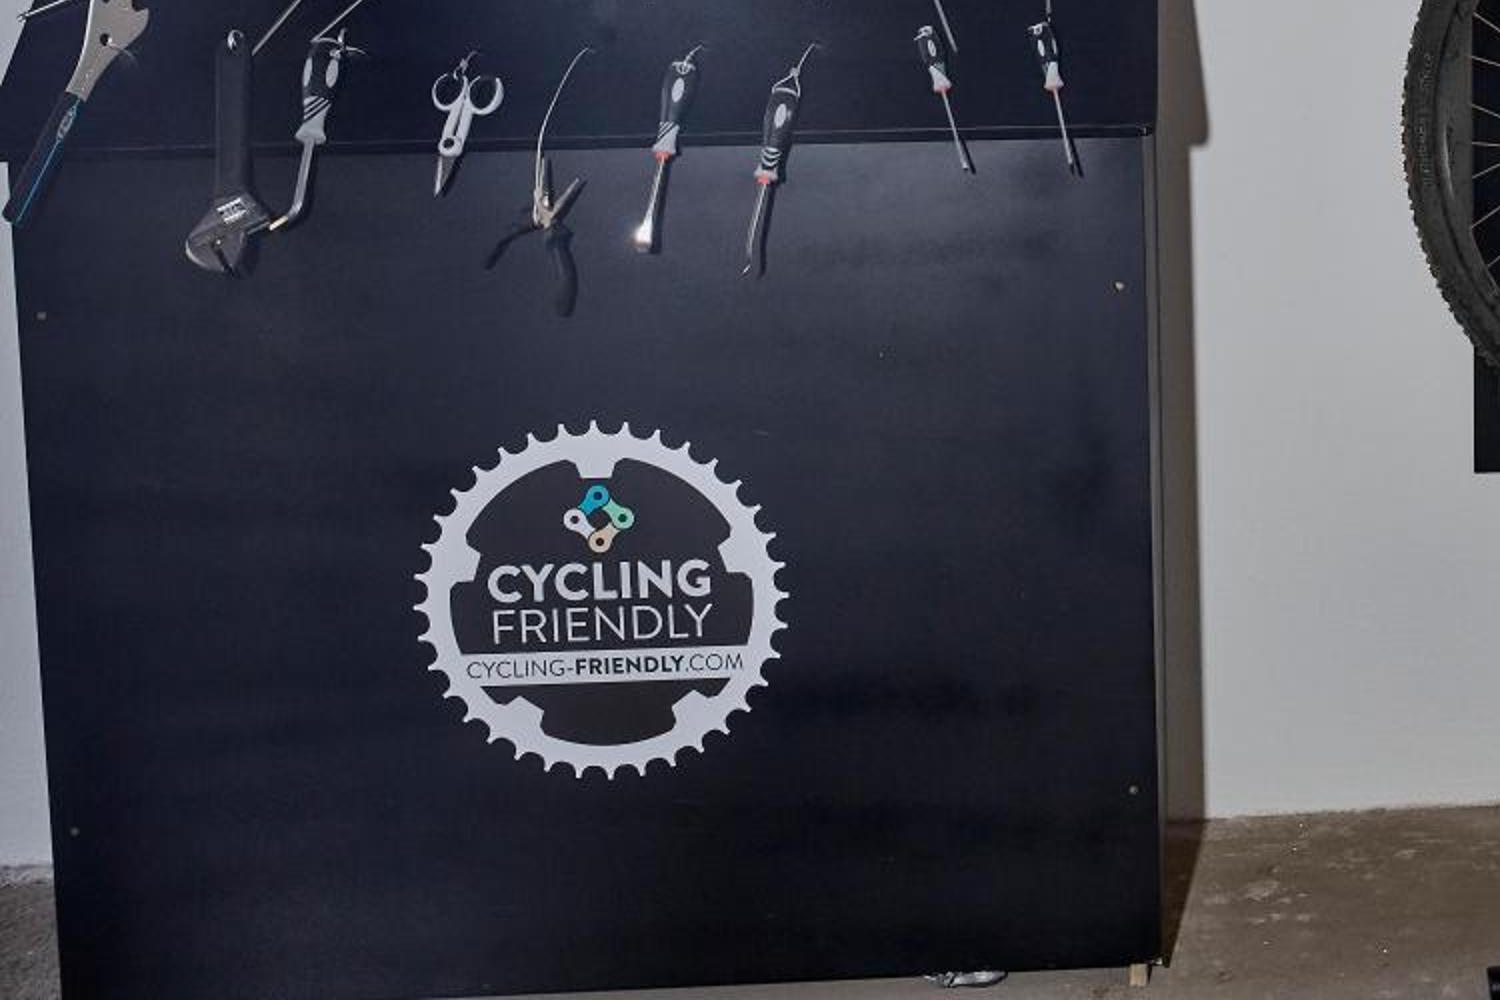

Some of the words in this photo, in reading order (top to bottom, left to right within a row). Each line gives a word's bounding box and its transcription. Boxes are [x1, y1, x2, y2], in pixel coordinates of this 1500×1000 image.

[486, 558, 713, 603] CYCLING
[493, 602, 713, 645] FRIENDLY
[466, 652, 744, 680] CYCLING-FRIENDLY.COM
